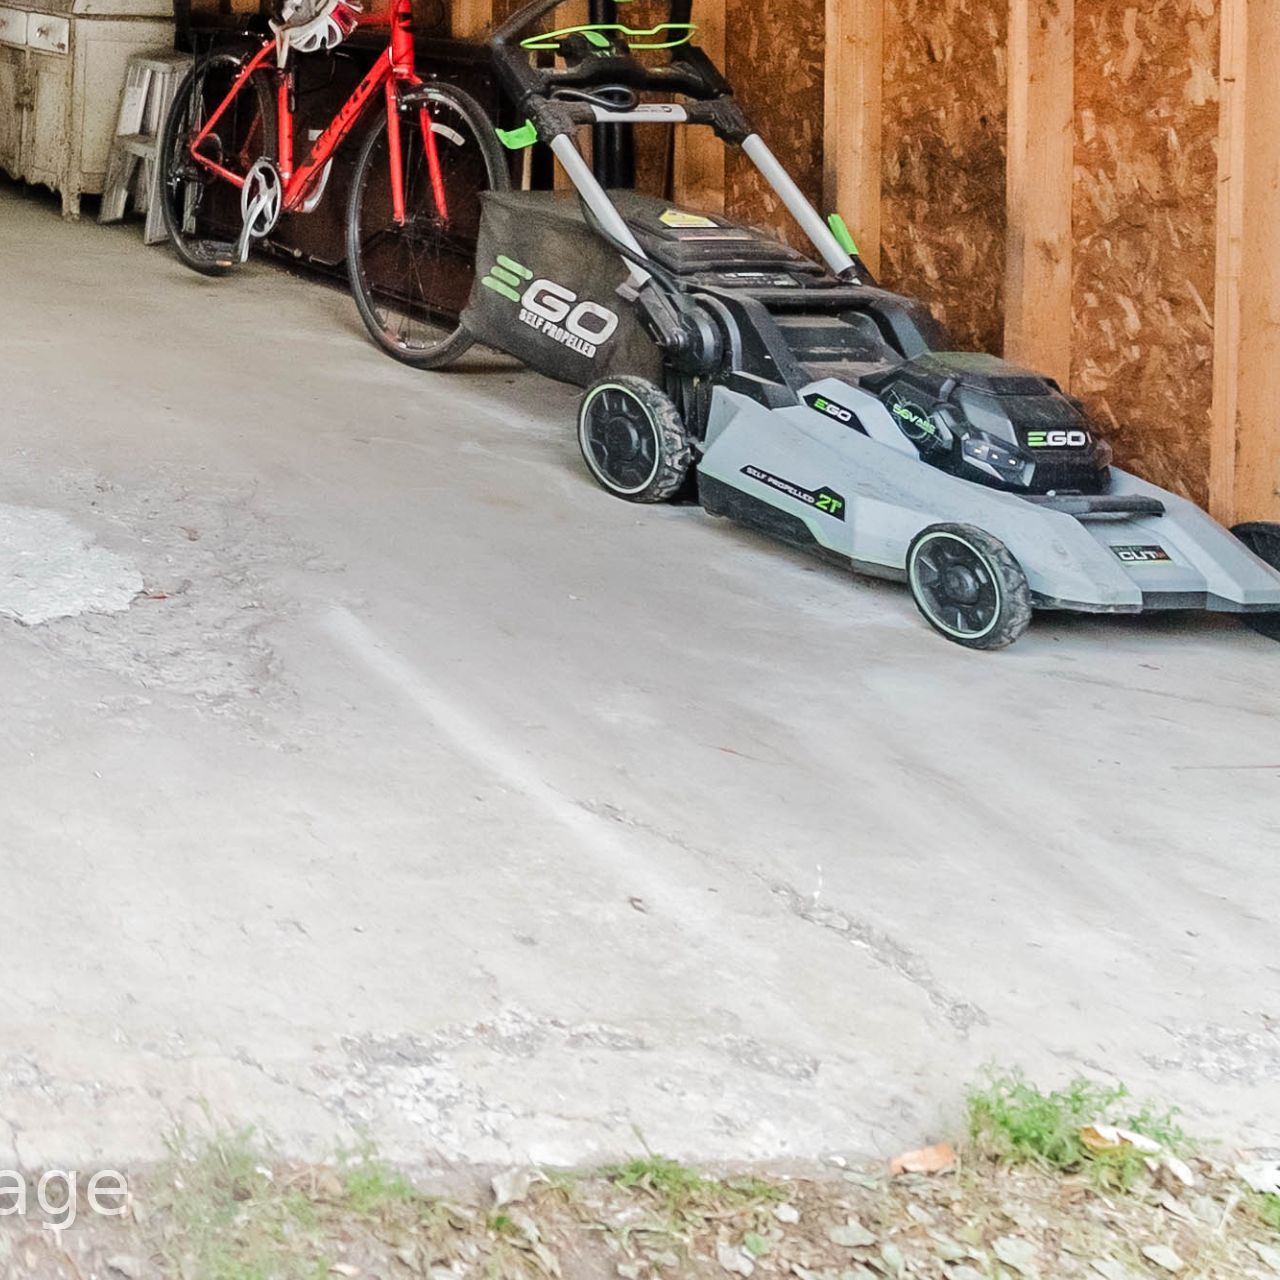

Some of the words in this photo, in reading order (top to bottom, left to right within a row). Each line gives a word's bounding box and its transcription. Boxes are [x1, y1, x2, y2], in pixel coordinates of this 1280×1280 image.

[481, 254, 619, 345] EGO
[518, 308, 545, 329] SELF
[541, 320, 597, 359] PROPELLED
[814, 397, 852, 422] EGO
[1027, 431, 1086, 447] EGO
[746, 466, 766, 480] SELF
[766, 474, 815, 504] PROPELLED
